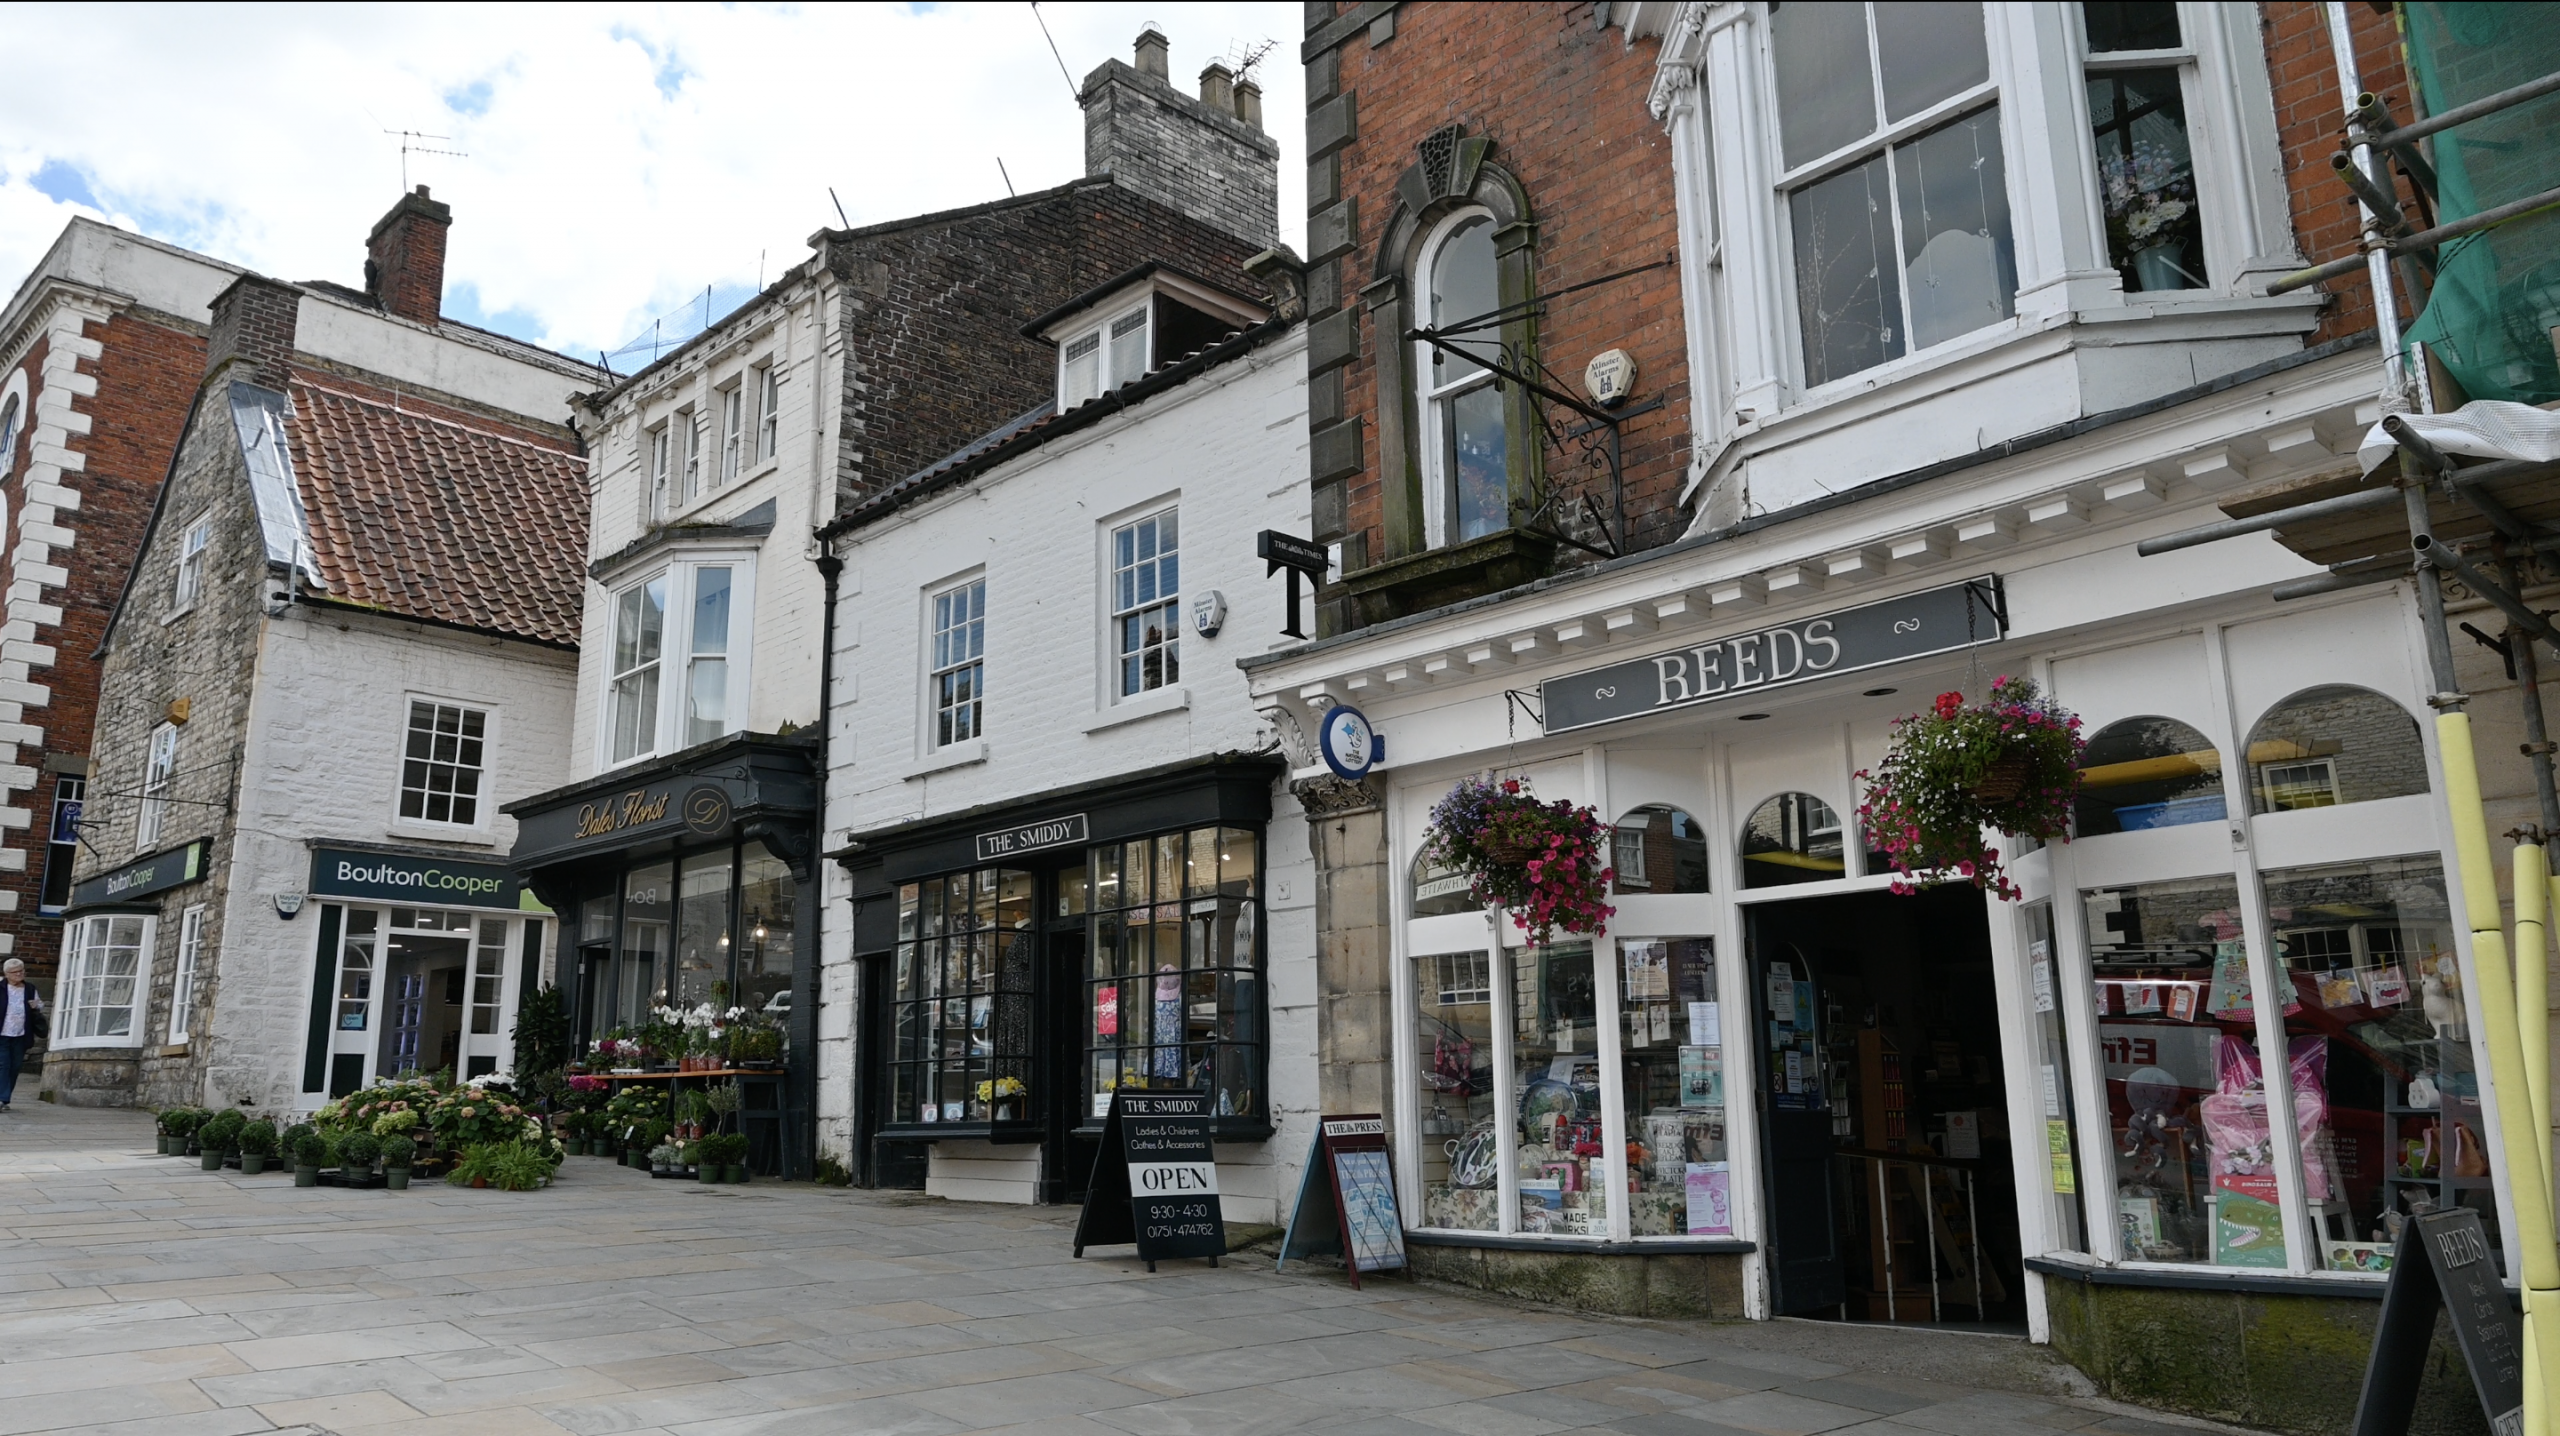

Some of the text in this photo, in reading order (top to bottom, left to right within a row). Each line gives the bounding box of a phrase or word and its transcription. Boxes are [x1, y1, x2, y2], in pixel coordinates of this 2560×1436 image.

[1591, 356, 1620, 372] Minster
[1592, 364, 1619, 379] Alarms
[1274, 540, 1322, 560] THE TIMES
[1194, 598, 1213, 608] Minster
[1194, 605, 1212, 614] Alarms
[1652, 619, 1842, 706] REEDS
[1345, 757, 1362, 765] LOTTERY
[575, 789, 670, 839] Dales Florist
[690, 797, 725, 825] D
[987, 821, 1073, 853] THE SMIDDY
[1125, 1100, 1200, 1112] THE SMIDDY
[1135, 1125, 1199, 1136] Ladies & Childrens
[1326, 1121, 1382, 1134] THE PRESS
[1131, 1139, 1205, 1150] Clothes & Accessories
[1142, 1167, 1207, 1190] OPEN
[1340, 1169, 1389, 1180] THE PRESS
[1563, 1213, 1588, 1223] MADE
[2436, 1226, 2484, 1269] REEDS
[2468, 1282, 2487, 1297] News
[2474, 1299, 2495, 1320] Cards
[2476, 1321, 2509, 1343] Stationery
[2496, 1365, 2520, 1383] Lottery
